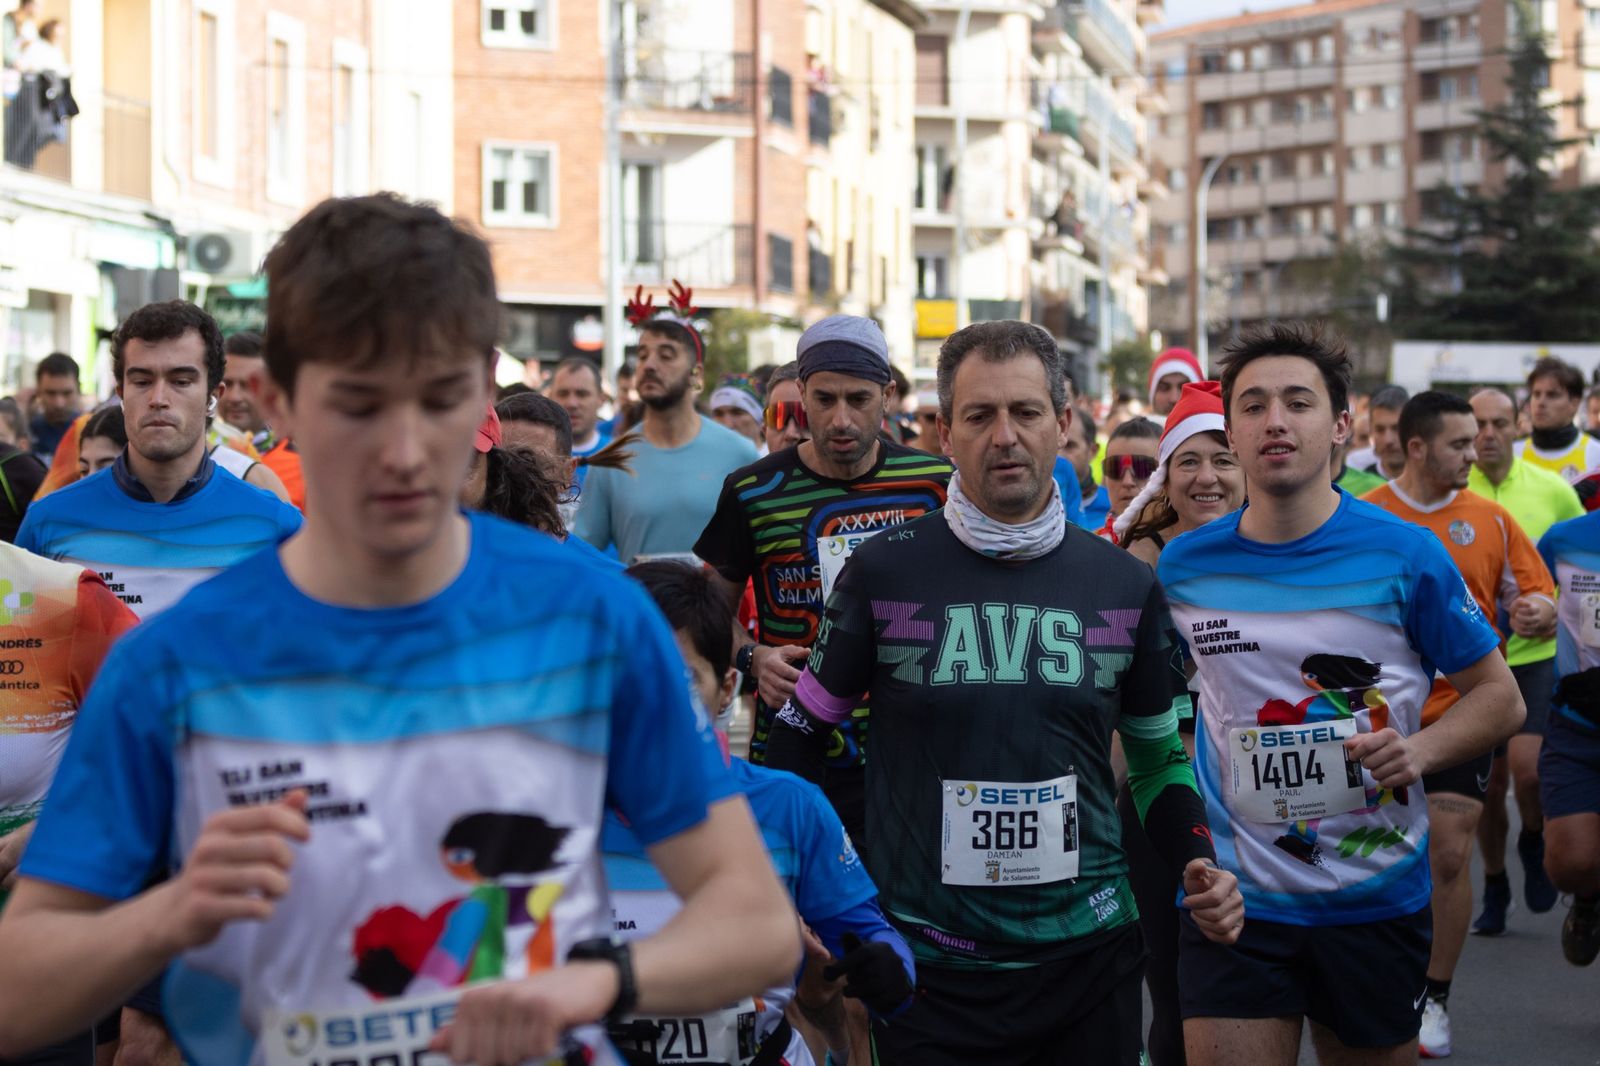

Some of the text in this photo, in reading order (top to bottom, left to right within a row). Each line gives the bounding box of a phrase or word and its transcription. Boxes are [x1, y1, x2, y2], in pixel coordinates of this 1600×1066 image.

[774, 566, 805, 582] SAN
[777, 586, 822, 605] SALM
[1205, 618, 1227, 630] SAN
[0, 638, 43, 649] NDRÉS
[1193, 630, 1240, 644] SILVESTRE
[930, 602, 1085, 688] AVS
[0, 680, 40, 690] ántica
[1260, 726, 1345, 748] SETEL
[1251, 749, 1325, 791] 1404
[980, 784, 1065, 805] SETEL
[1279, 789, 1302, 798] PAUL
[1289, 801, 1325, 811] Ayuntamiento
[1298, 808, 1327, 818] Salamanca
[971, 810, 1038, 850] 366
[987, 851, 1023, 859] DAMIAN
[1002, 867, 1040, 875] Ayuntamiento
[324, 1003, 458, 1048] SETE
